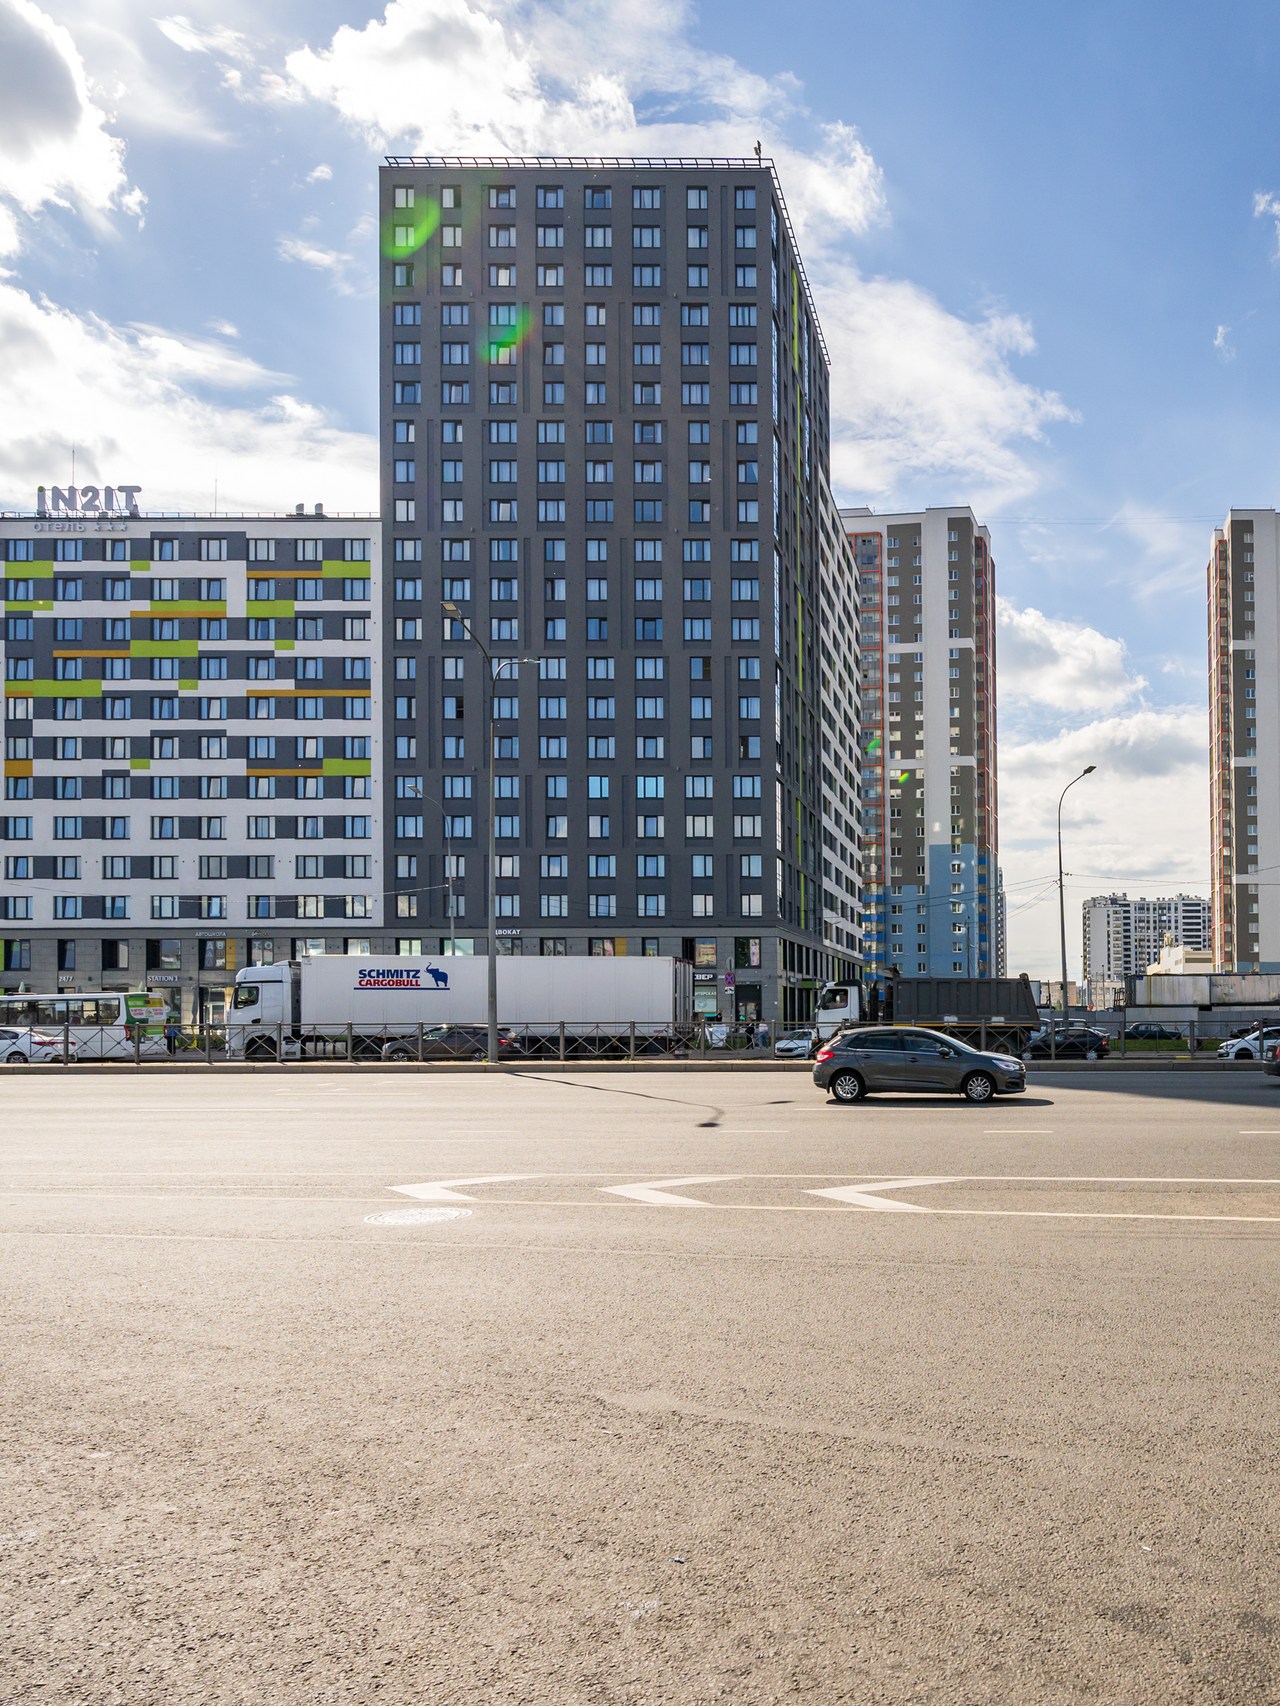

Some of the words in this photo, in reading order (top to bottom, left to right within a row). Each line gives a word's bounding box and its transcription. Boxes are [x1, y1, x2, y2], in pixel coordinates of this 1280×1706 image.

[33, 521, 86, 532] отель
[358, 969, 421, 979] SCHMITZ
[358, 979, 421, 987] CARGOBULL
